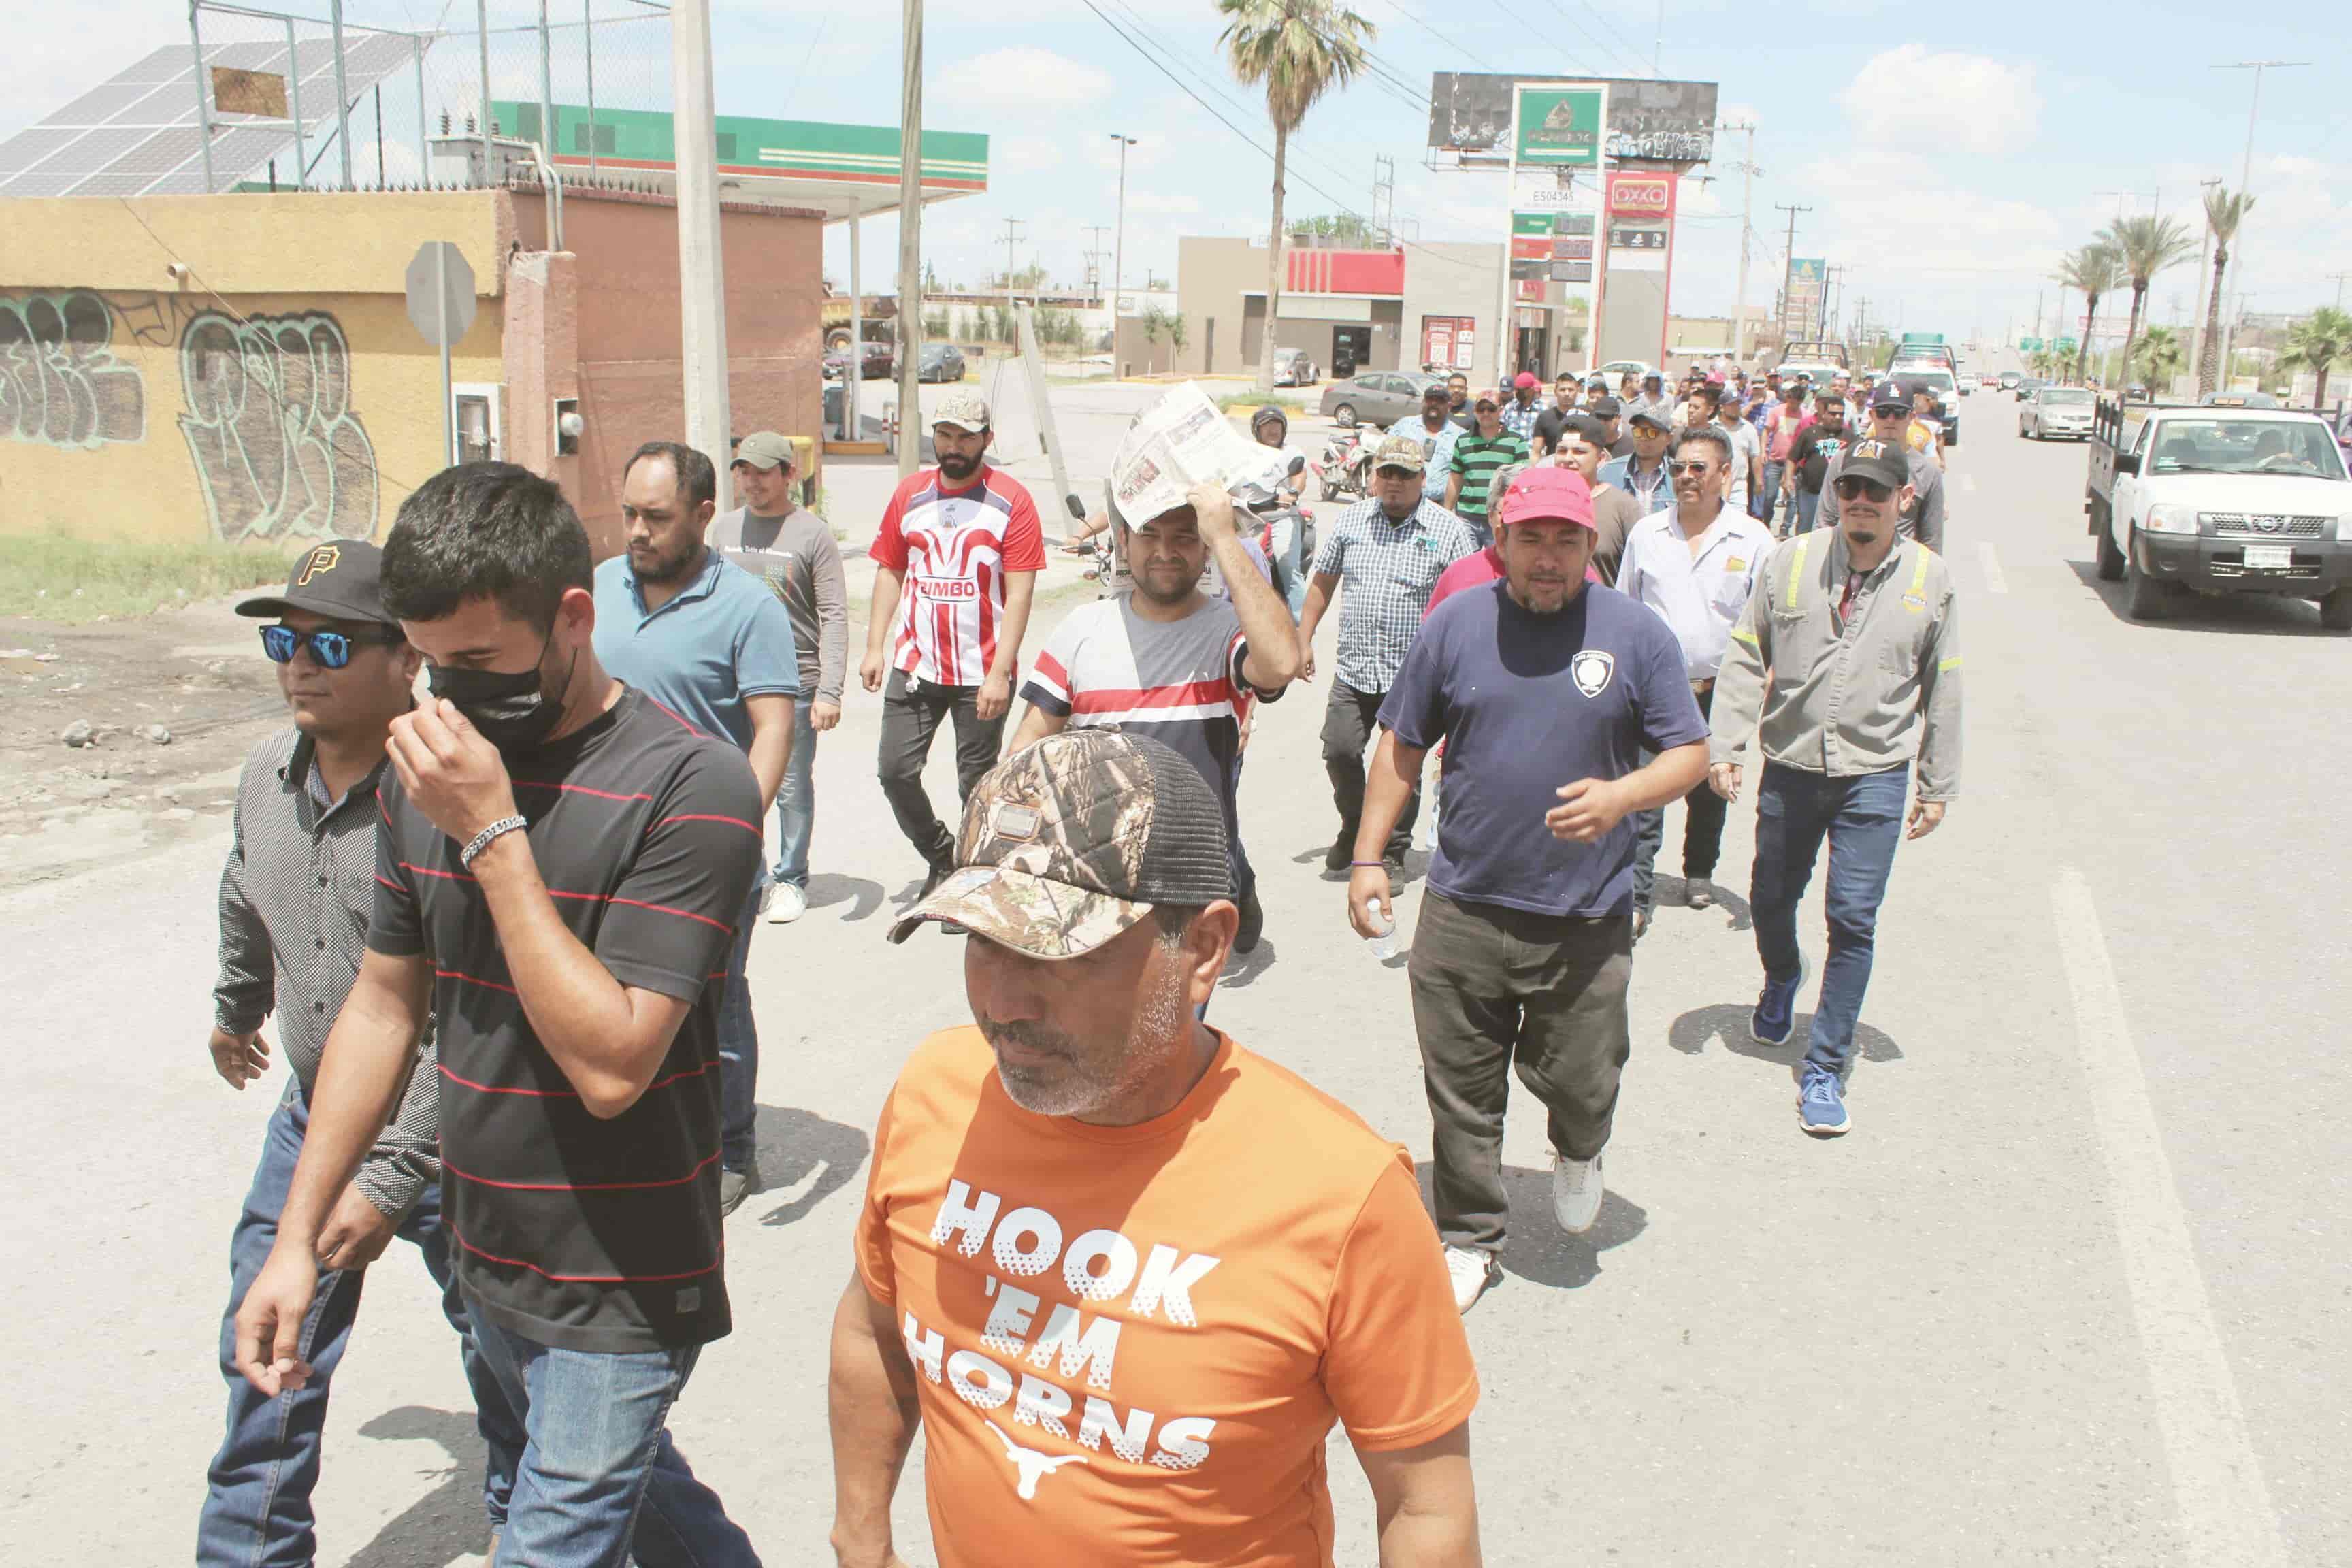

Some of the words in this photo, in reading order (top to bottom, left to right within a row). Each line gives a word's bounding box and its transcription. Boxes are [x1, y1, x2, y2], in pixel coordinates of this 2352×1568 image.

[1614, 186, 1664, 204] OXXO
[1852, 440, 1887, 459] CAT
[298, 546, 340, 585] P
[921, 581, 975, 597] BIMBO
[930, 1179, 1220, 1327] HOOK
[980, 1275, 1122, 1391] 'EM
[903, 1312, 1217, 1470] HORNS
